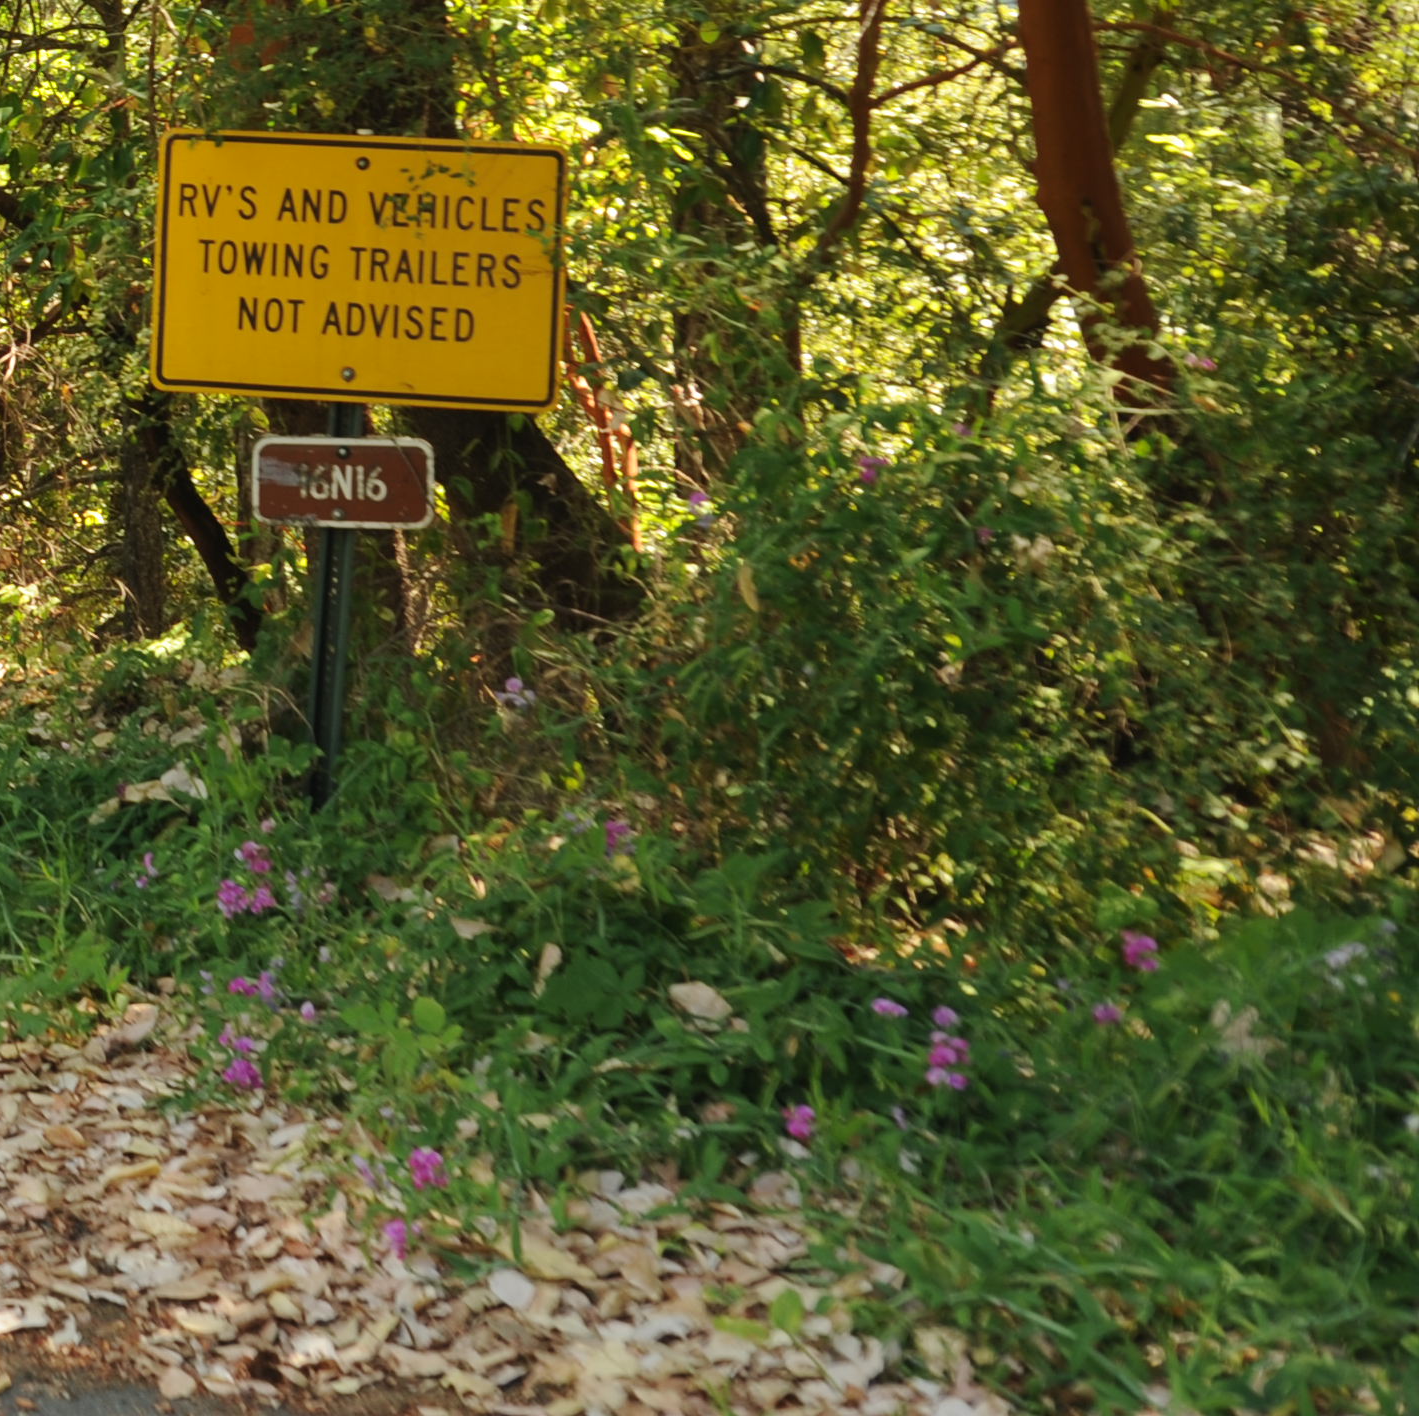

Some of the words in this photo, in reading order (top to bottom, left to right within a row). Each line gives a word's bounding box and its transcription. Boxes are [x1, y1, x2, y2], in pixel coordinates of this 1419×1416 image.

[178, 183, 257, 220] RV'S
[278, 188, 348, 224] AND
[369, 191, 546, 233] VEHICLES
[199, 240, 329, 279] TOWING
[350, 247, 522, 288] TRAILERS
[238, 297, 305, 333] NOT
[322, 302, 475, 342] ADVISED
[299, 464, 387, 502] 16N16
